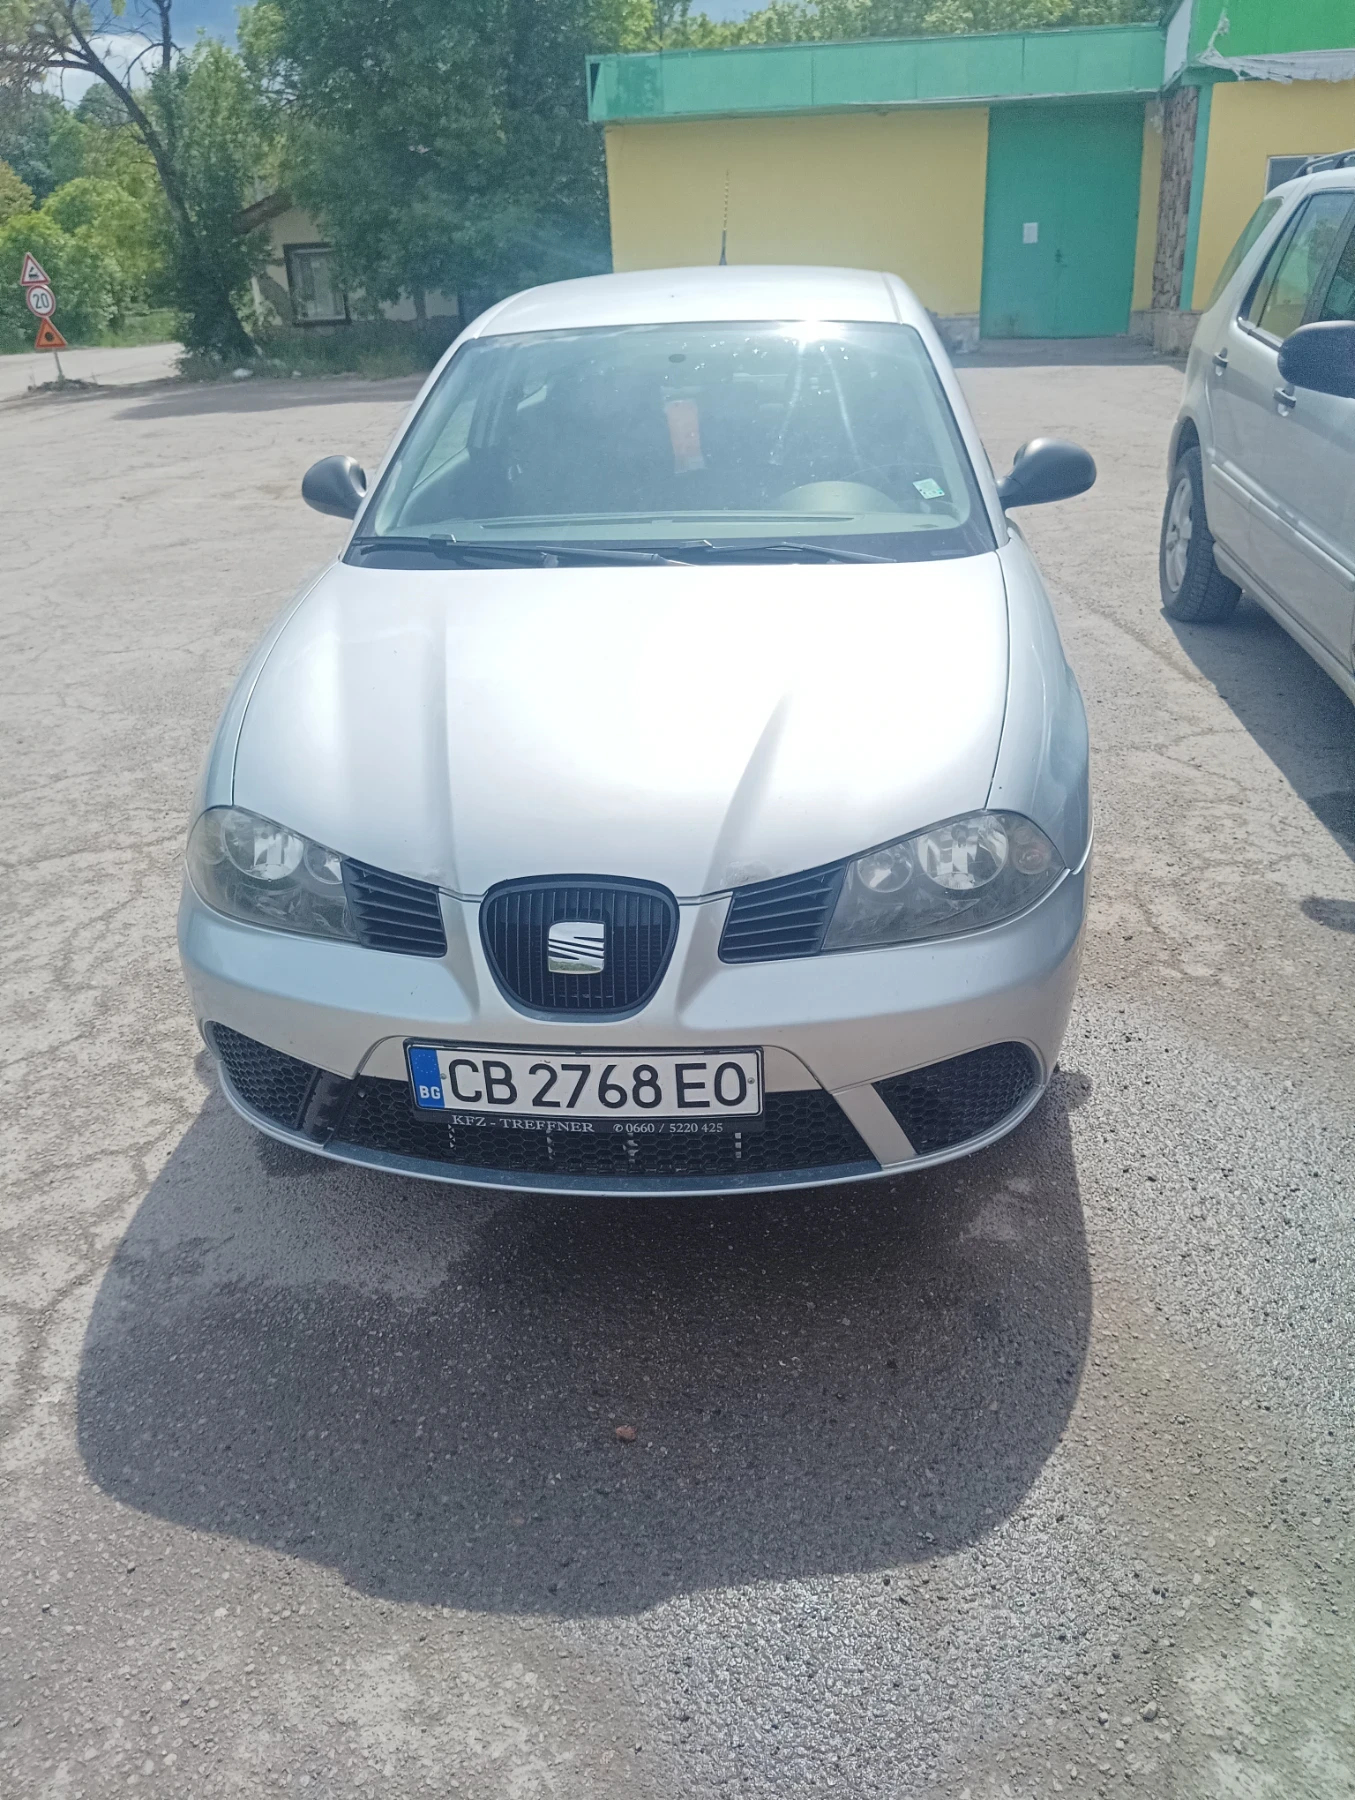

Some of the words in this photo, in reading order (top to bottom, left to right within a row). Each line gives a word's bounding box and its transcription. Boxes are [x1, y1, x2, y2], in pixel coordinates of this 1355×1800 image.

[32, 293, 50, 308] 20
[448, 1059, 518, 1105] CB
[529, 1063, 662, 1109] 2768
[419, 1085, 441, 1099] BG
[452, 1115, 486, 1127] KFZ
[499, 1118, 595, 1133] TREFFNER
[625, 1123, 655, 1133] 0660
[669, 1123, 698, 1133] 5220
[701, 1122, 724, 1133] 425
